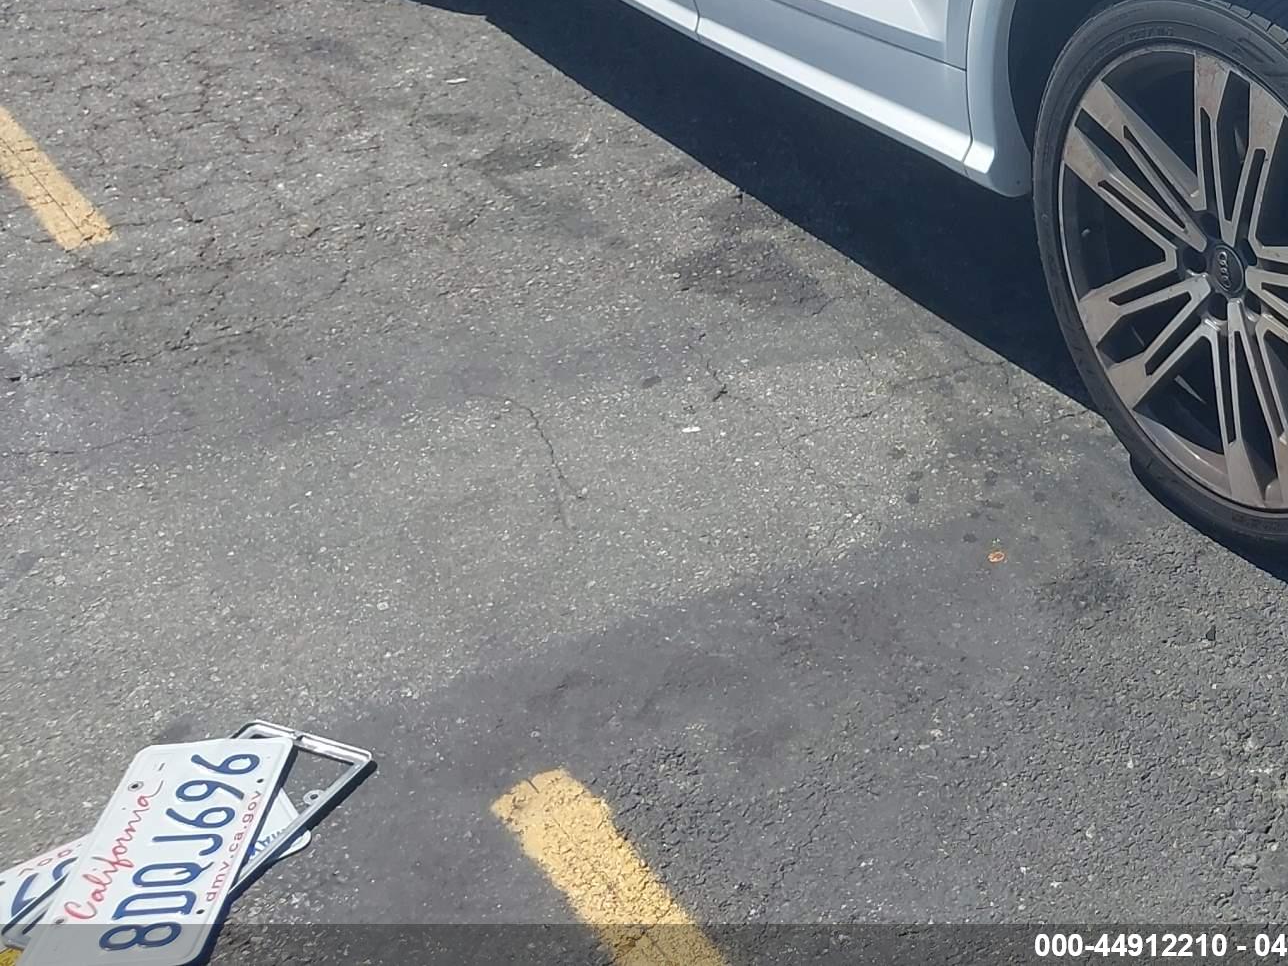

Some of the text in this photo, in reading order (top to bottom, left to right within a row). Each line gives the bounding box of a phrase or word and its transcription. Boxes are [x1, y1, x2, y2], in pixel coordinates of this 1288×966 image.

[63, 779, 164, 920] California
[99, 753, 261, 951] 8DQJ696
[205, 790, 262, 903] dmv.ca.gov
